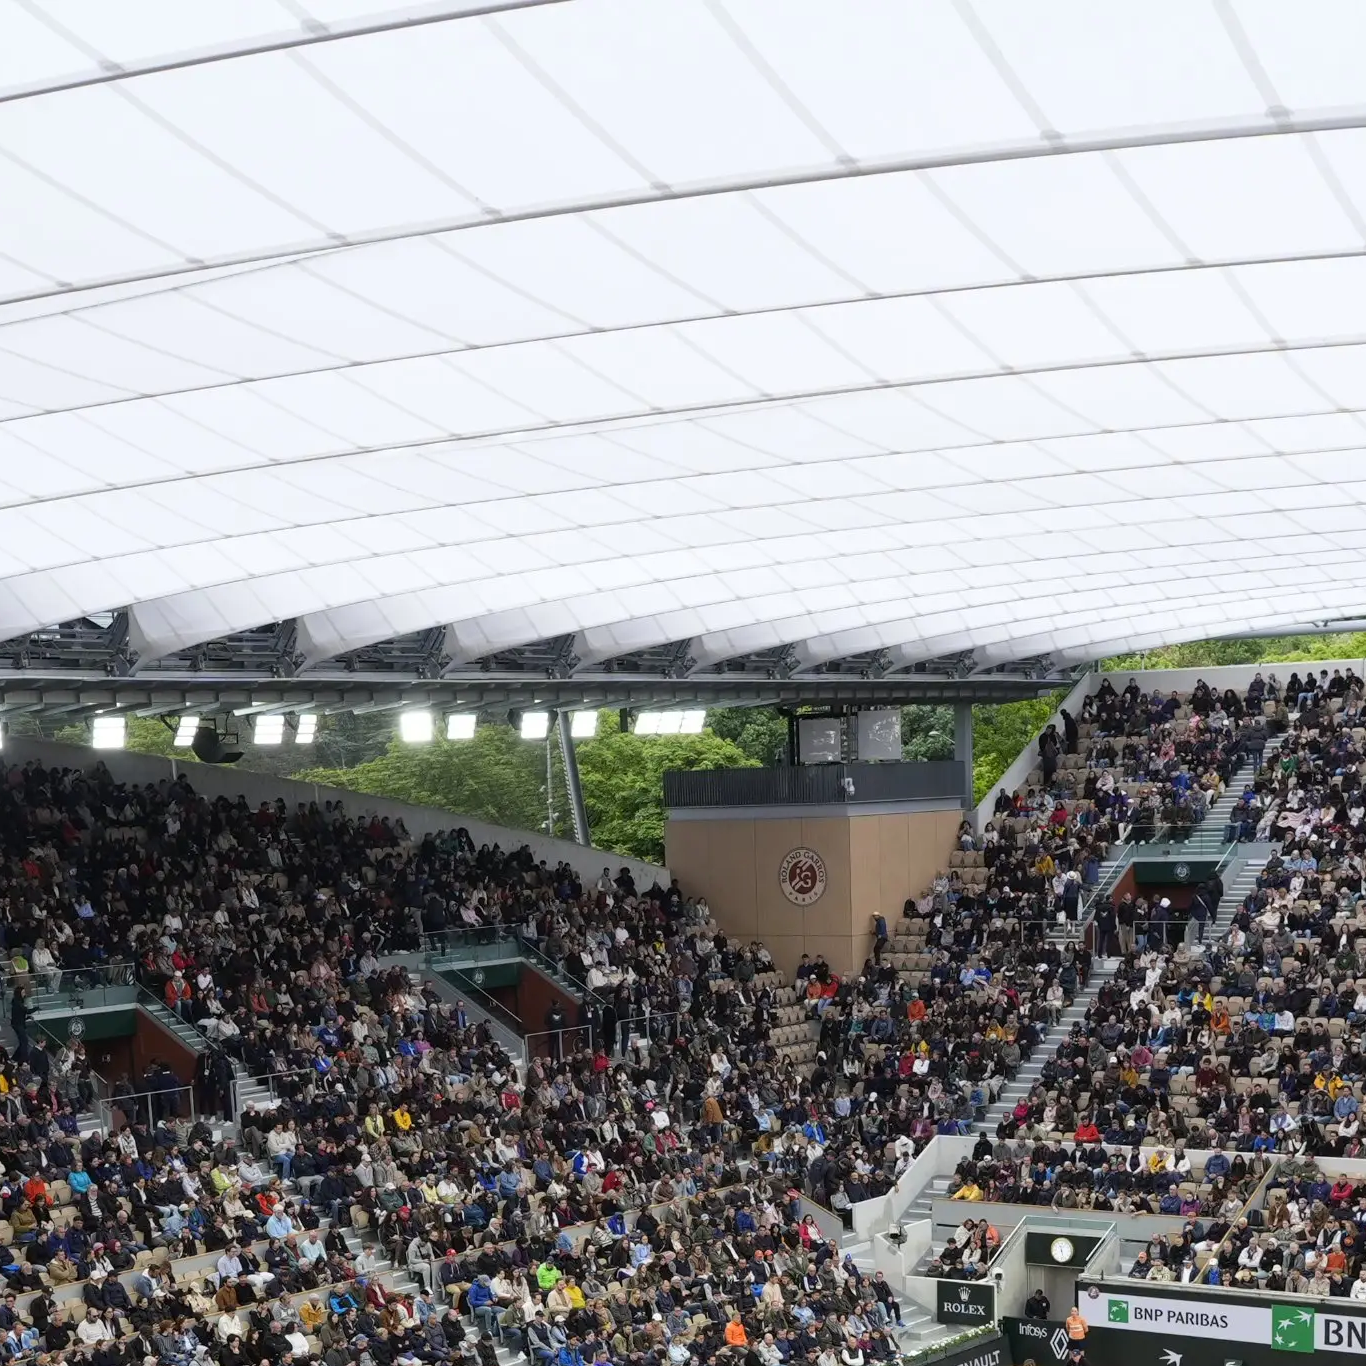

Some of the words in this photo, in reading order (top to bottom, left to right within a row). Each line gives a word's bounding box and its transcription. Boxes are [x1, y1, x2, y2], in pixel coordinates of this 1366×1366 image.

[943, 1302, 986, 1315] ROLEX
[1134, 1307, 1163, 1322] BNP
[1167, 1309, 1229, 1329] PARIBAS
[1018, 1323, 1048, 1339] Infosys
